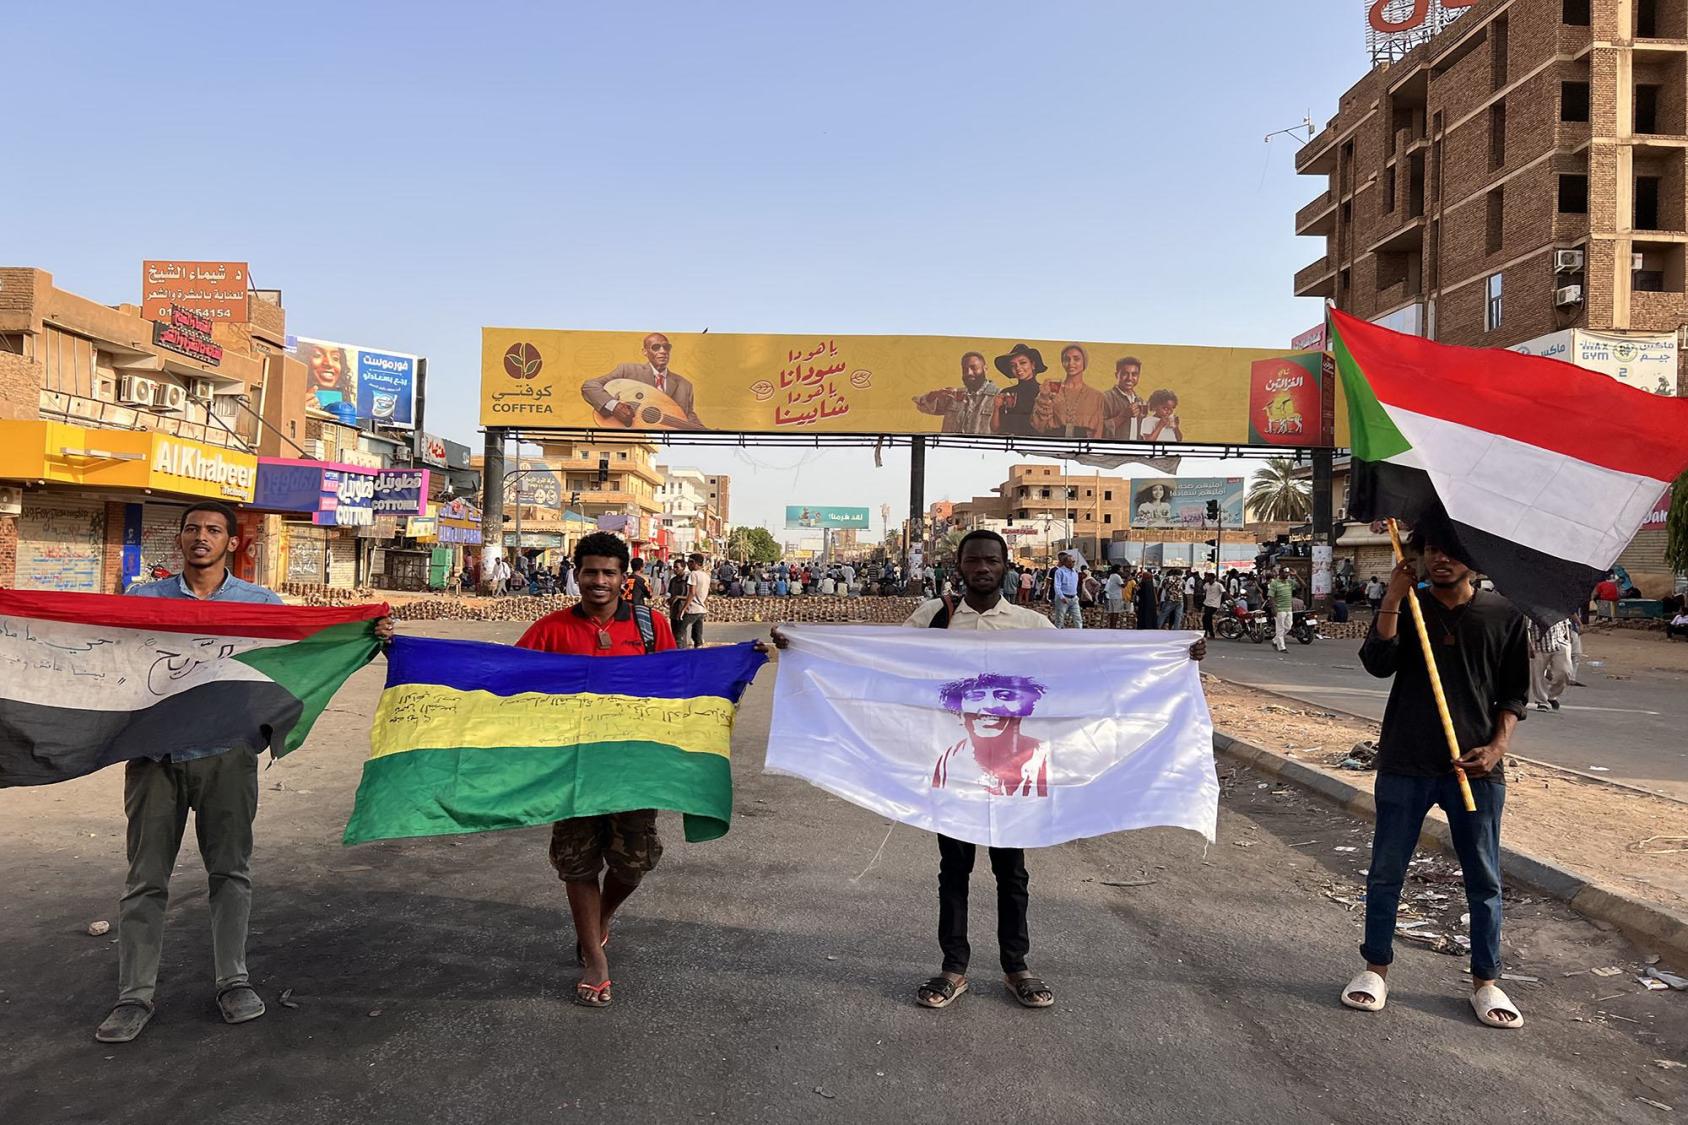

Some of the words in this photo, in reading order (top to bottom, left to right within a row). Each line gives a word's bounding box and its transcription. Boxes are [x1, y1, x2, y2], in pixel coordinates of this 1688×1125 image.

[149, 264, 186, 284] الشيخ
[189, 265, 226, 284] شيماء
[147, 288, 176, 301] والشعر
[178, 288, 212, 302] بالبشرة
[214, 289, 244, 303] للعناية
[159, 307, 231, 318] 0154154
[363, 355, 409, 371] فورموست
[1640, 354, 1671, 363] جيم
[780, 361, 846, 389] سودانا
[1265, 376, 1304, 392] الغزالتين
[491, 383, 553, 402] كوفتي
[492, 403, 553, 413] COFFTEA
[337, 472, 374, 504] قطونيل
[374, 472, 422, 494] قطونيل
